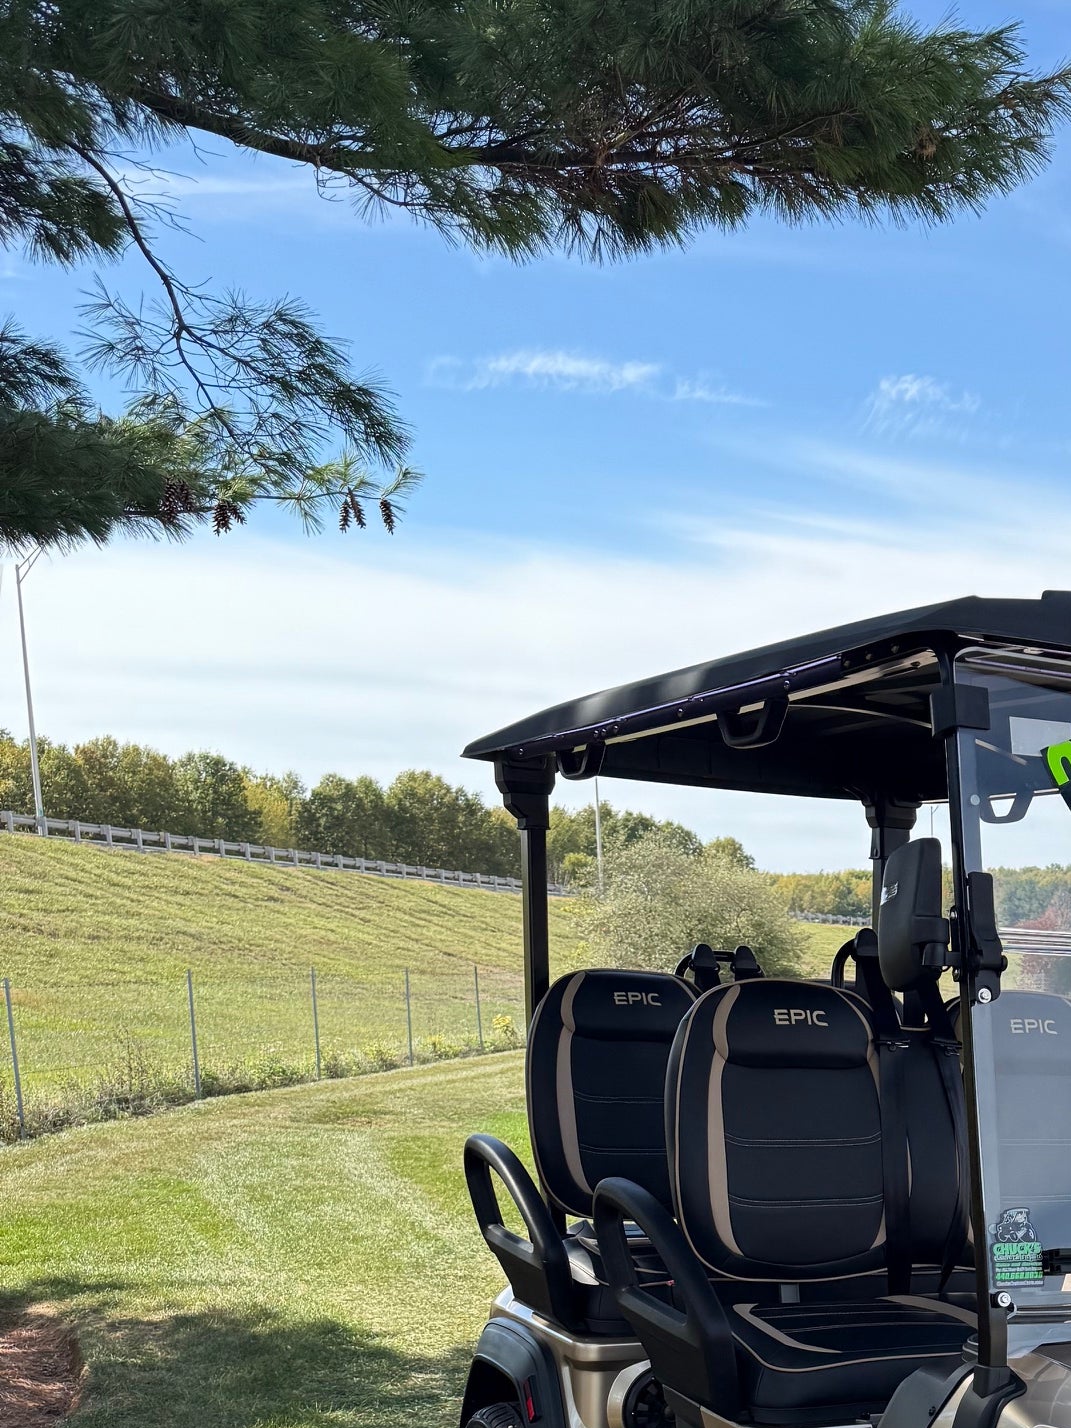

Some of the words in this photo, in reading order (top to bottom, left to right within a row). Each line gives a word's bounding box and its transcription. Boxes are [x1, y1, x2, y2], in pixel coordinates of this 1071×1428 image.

[613, 991, 662, 1006] EPIC
[773, 1008, 829, 1027] EPIC
[1010, 1018, 1058, 1035] EPIC
